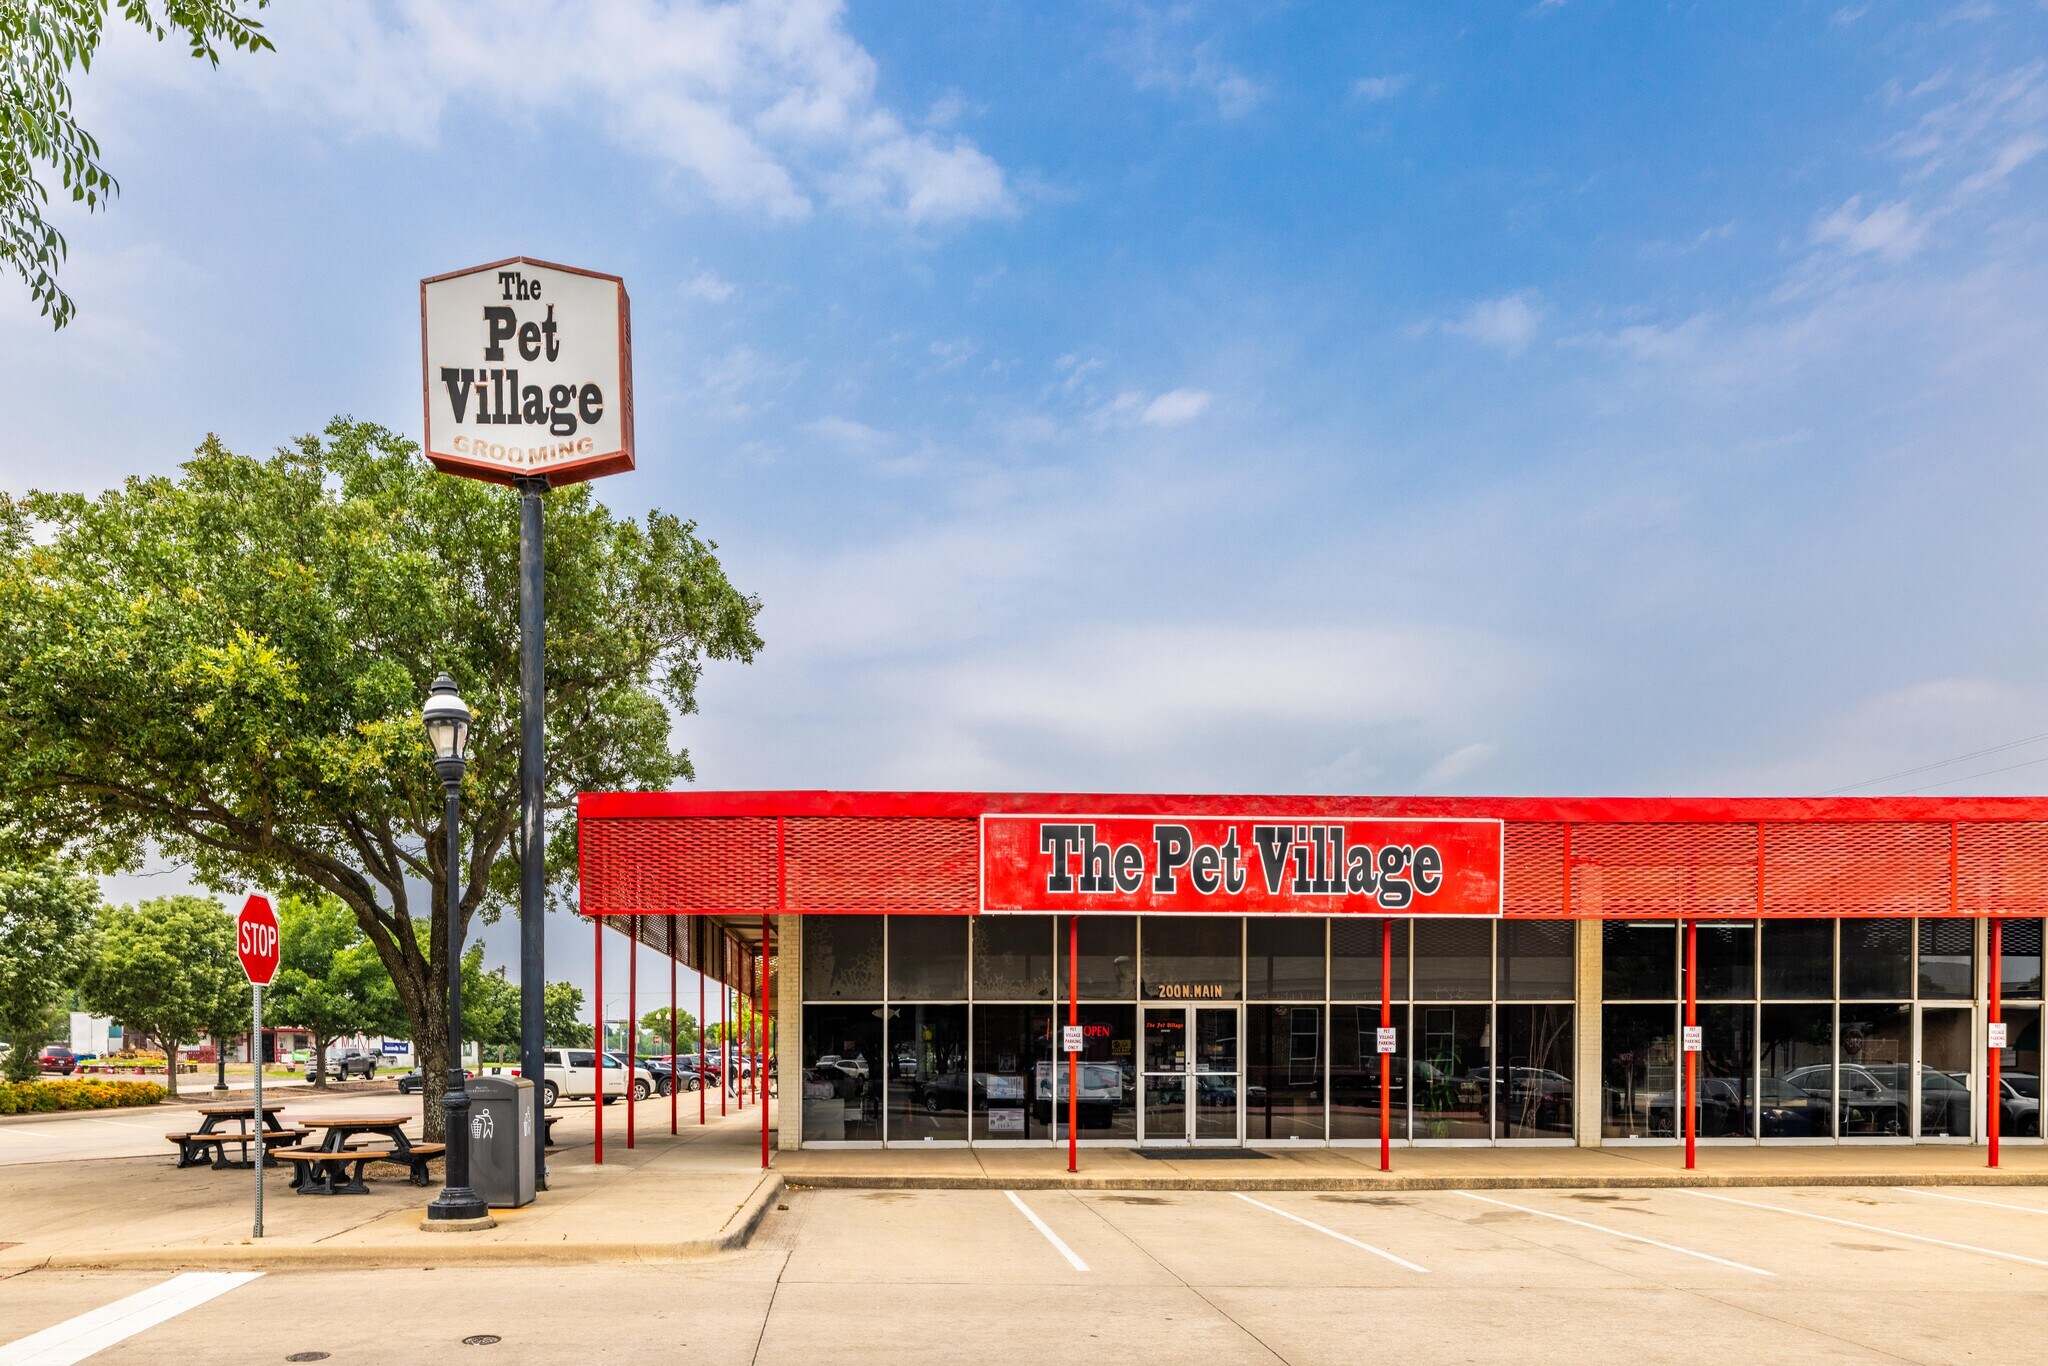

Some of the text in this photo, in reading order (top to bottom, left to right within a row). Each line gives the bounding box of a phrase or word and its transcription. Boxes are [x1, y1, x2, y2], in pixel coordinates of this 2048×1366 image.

[498, 271, 541, 300] The
[483, 303, 560, 362] Pet
[440, 366, 603, 436] Village
[453, 435, 594, 465] GROOMING
[1040, 824, 1443, 909] The Pet Village
[241, 921, 277, 957] STOP
[1083, 1025, 1110, 1037] OPEN
